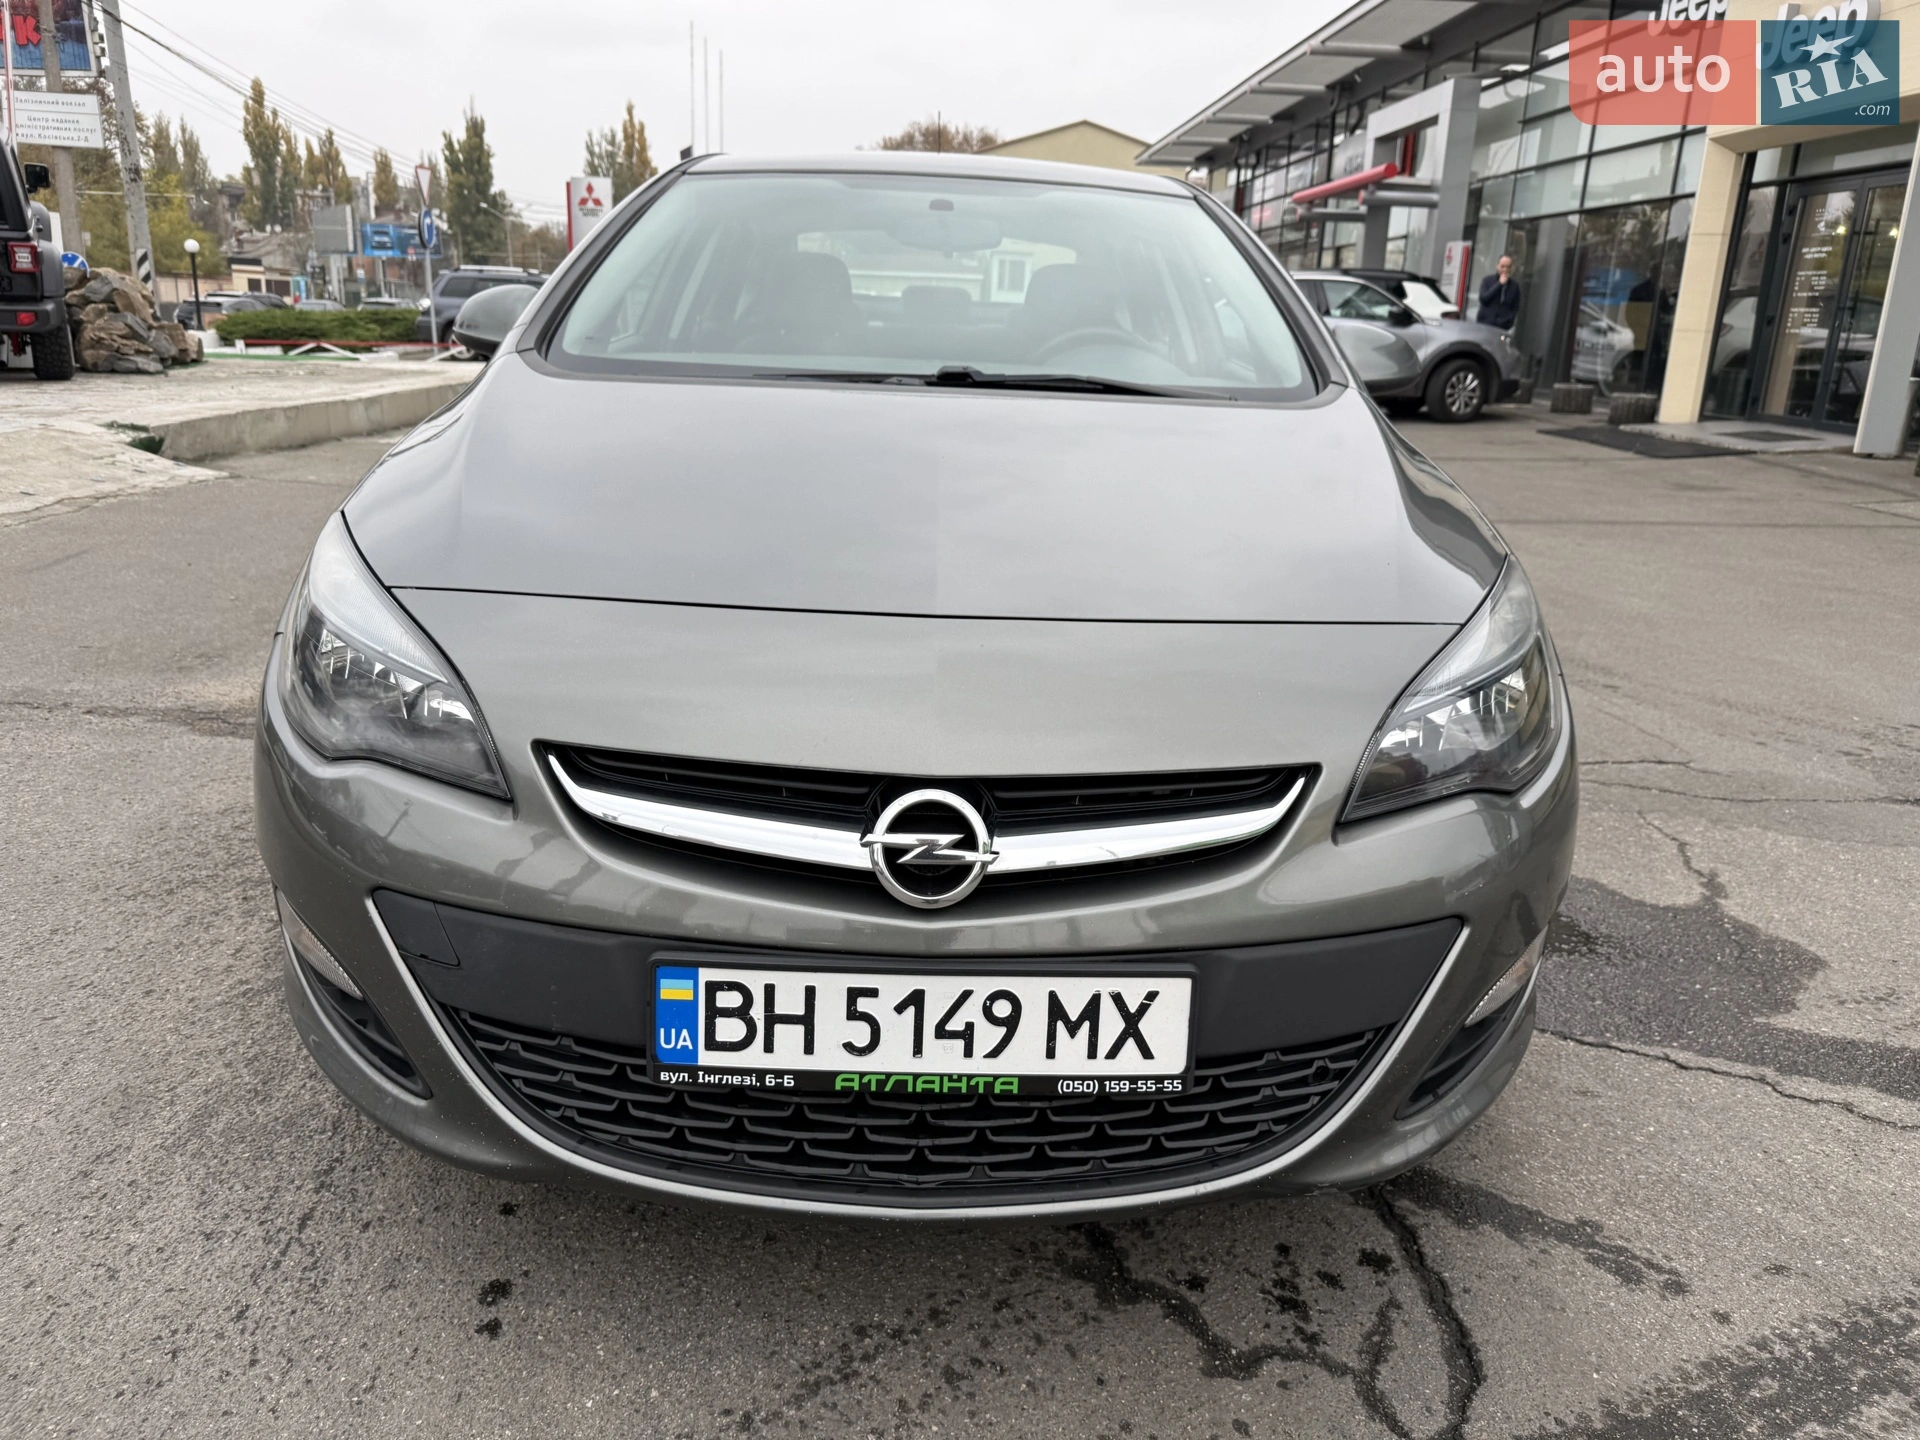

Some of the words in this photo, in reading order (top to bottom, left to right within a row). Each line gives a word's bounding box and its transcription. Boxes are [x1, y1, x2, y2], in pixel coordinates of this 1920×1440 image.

[1761, 0, 1870, 67] Jeep
[704, 980, 816, 1055] BH
[842, 986, 1023, 1059] 5149
[1045, 989, 1160, 1060] MX
[659, 1027, 693, 1050] UA
[660, 1071, 693, 1084] вул.
[697, 1071, 760, 1087] Інглезі,
[765, 1074, 795, 1087] 6-Б
[1057, 1079, 1099, 1094] (050)
[1103, 1080, 1183, 1093] 159-55-55
